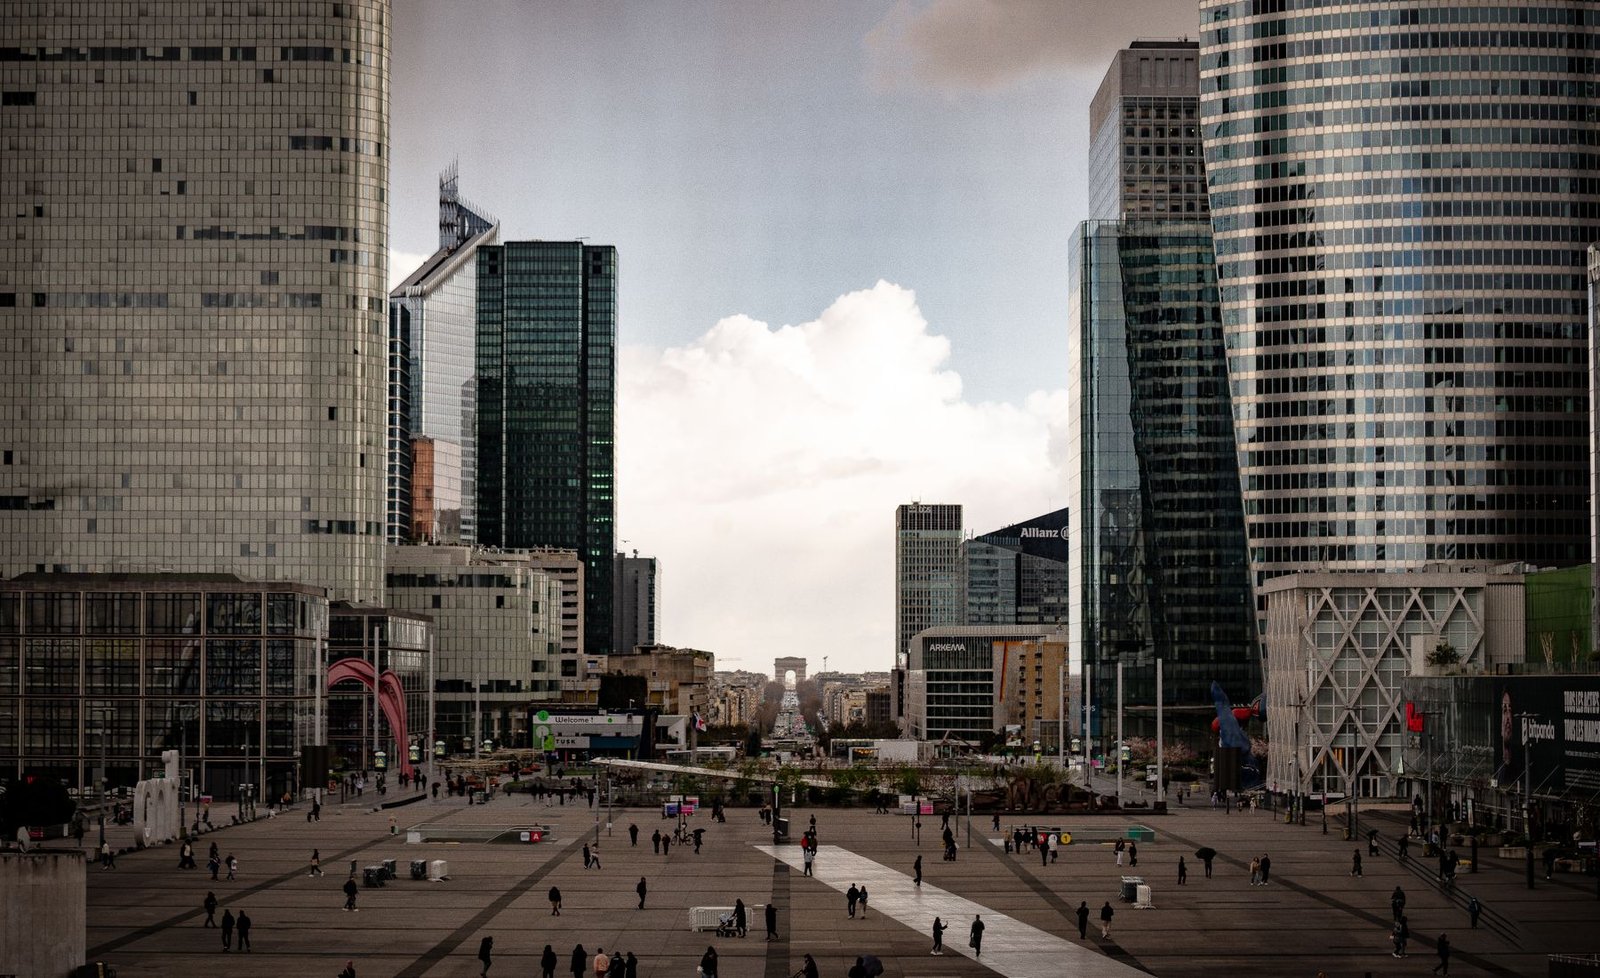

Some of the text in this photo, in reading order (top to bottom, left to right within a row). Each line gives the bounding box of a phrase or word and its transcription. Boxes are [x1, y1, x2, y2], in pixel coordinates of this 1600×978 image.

[1020, 527, 1059, 538] Allianz
[929, 643, 966, 652] ARKEMA
[1528, 718, 1555, 744] bitpanda
